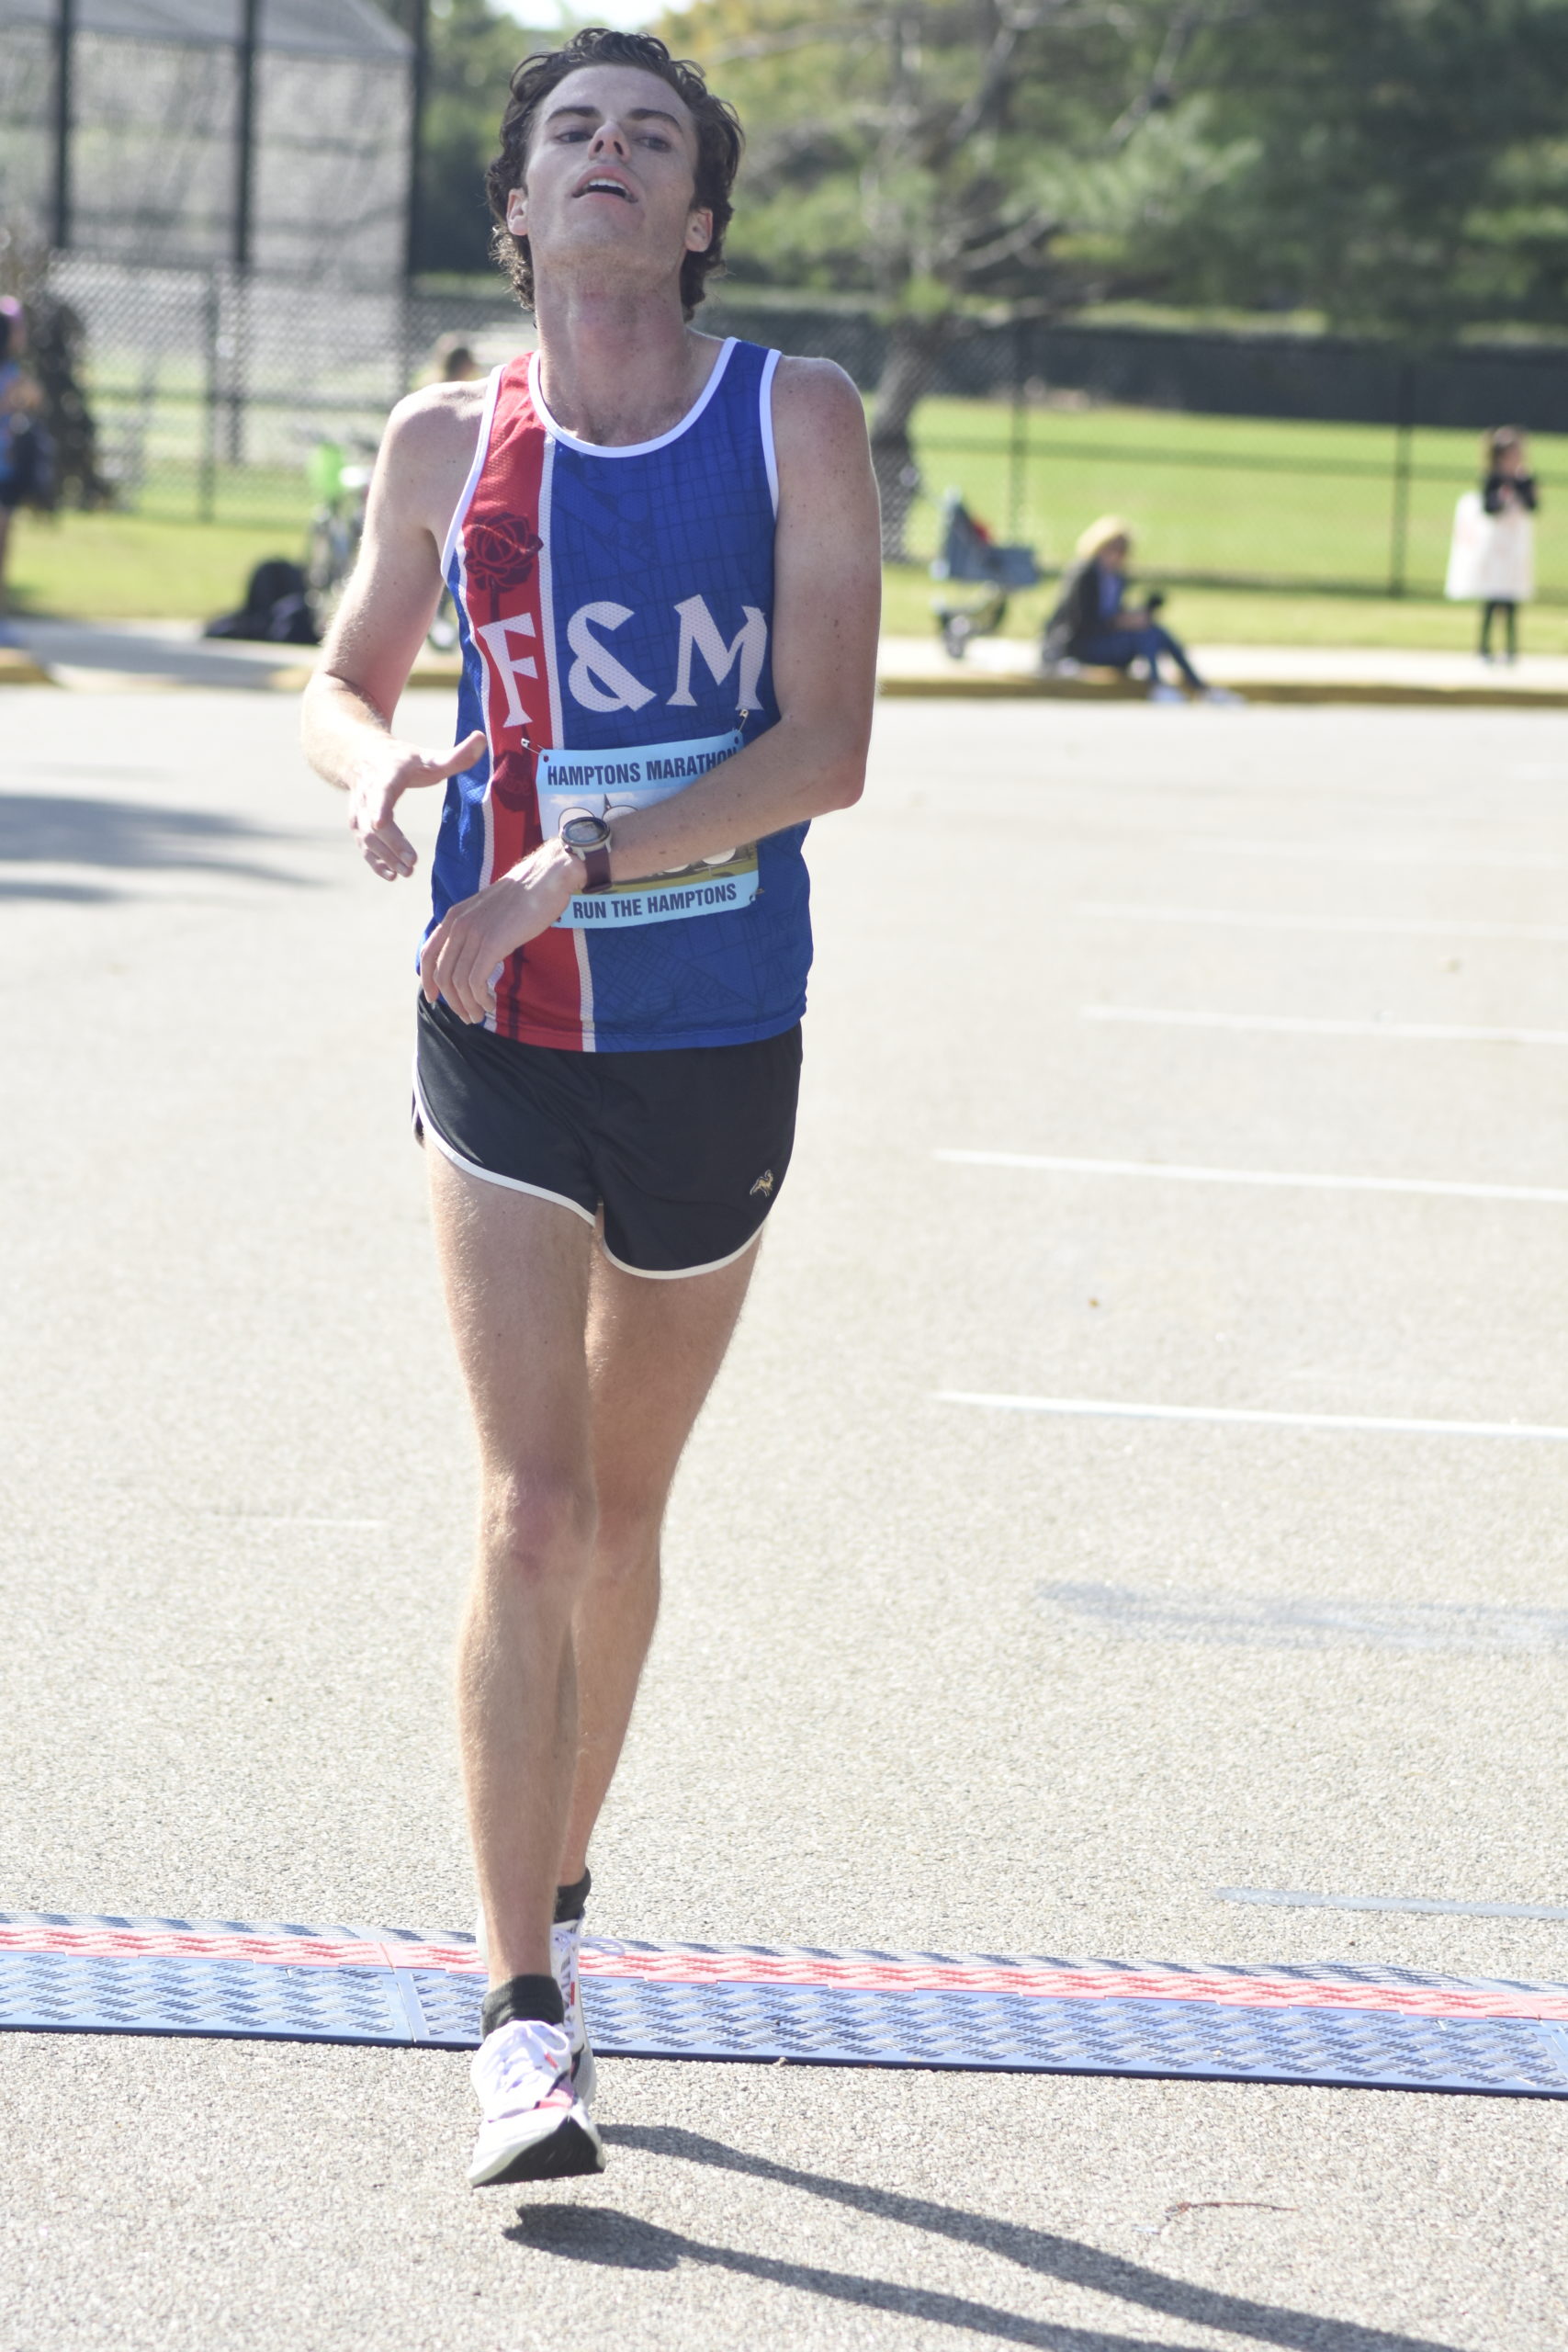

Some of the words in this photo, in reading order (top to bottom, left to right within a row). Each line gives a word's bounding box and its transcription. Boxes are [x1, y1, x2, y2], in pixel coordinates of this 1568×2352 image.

[478, 613, 538, 728] F
[567, 602, 657, 712] &
[666, 594, 768, 711] M
[547, 763, 641, 786] HAMPTONS
[573, 900, 606, 919] RUN
[612, 899, 642, 917] THE
[648, 884, 737, 913] HAMPTONS
